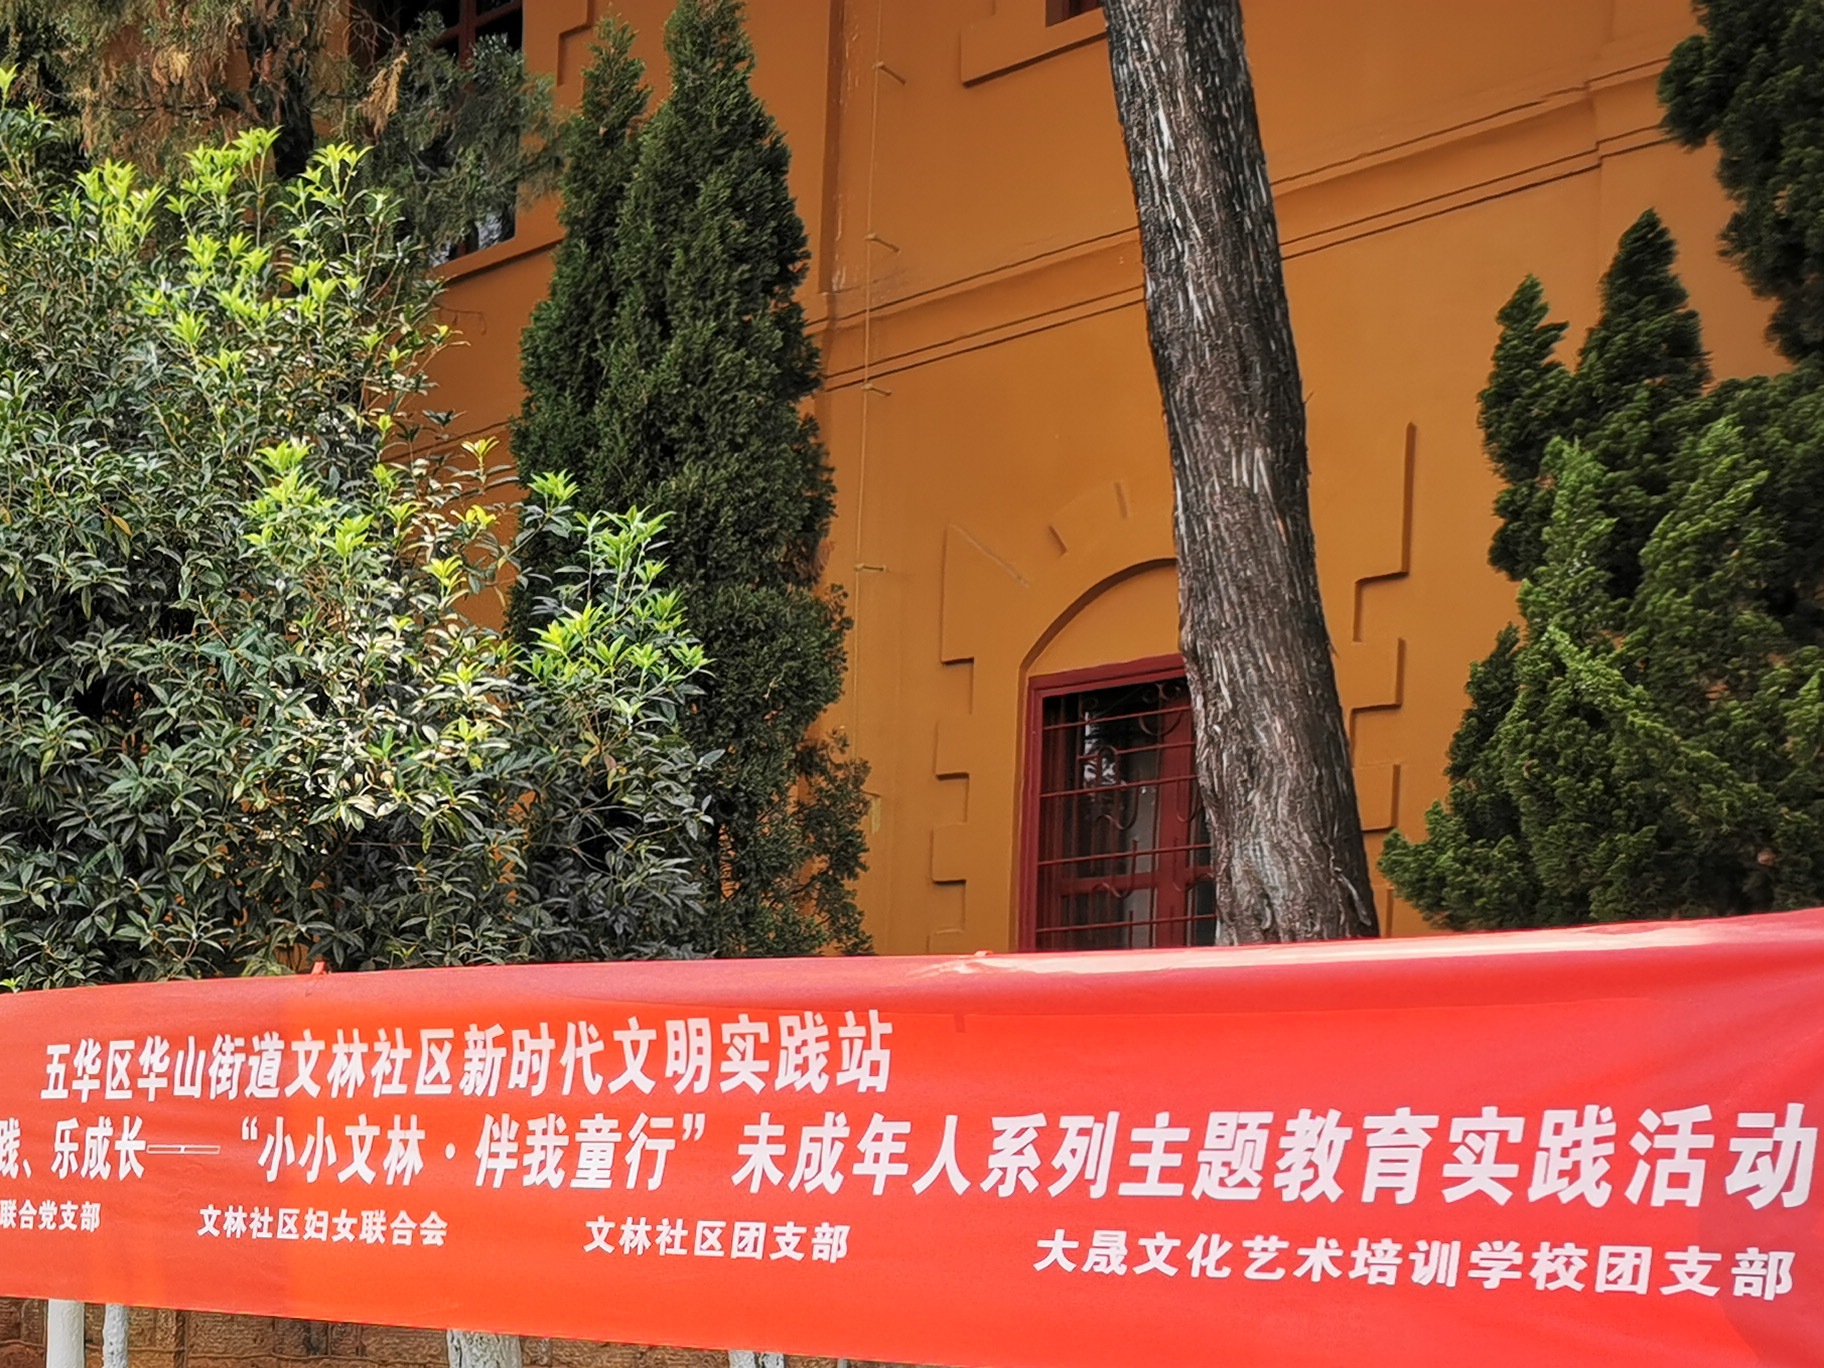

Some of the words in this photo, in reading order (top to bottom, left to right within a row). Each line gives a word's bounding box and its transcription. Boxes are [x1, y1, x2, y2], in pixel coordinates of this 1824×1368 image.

[40, 1010, 893, 1103] 五华区华山街道文林社区新时代文明实践站
[197, 1204, 448, 1247] 文林社区妇女联合会
[583, 1215, 851, 1264] 文林社区团支部
[1033, 1228, 1796, 1301] 大晟文化艺术培训学校团支部
